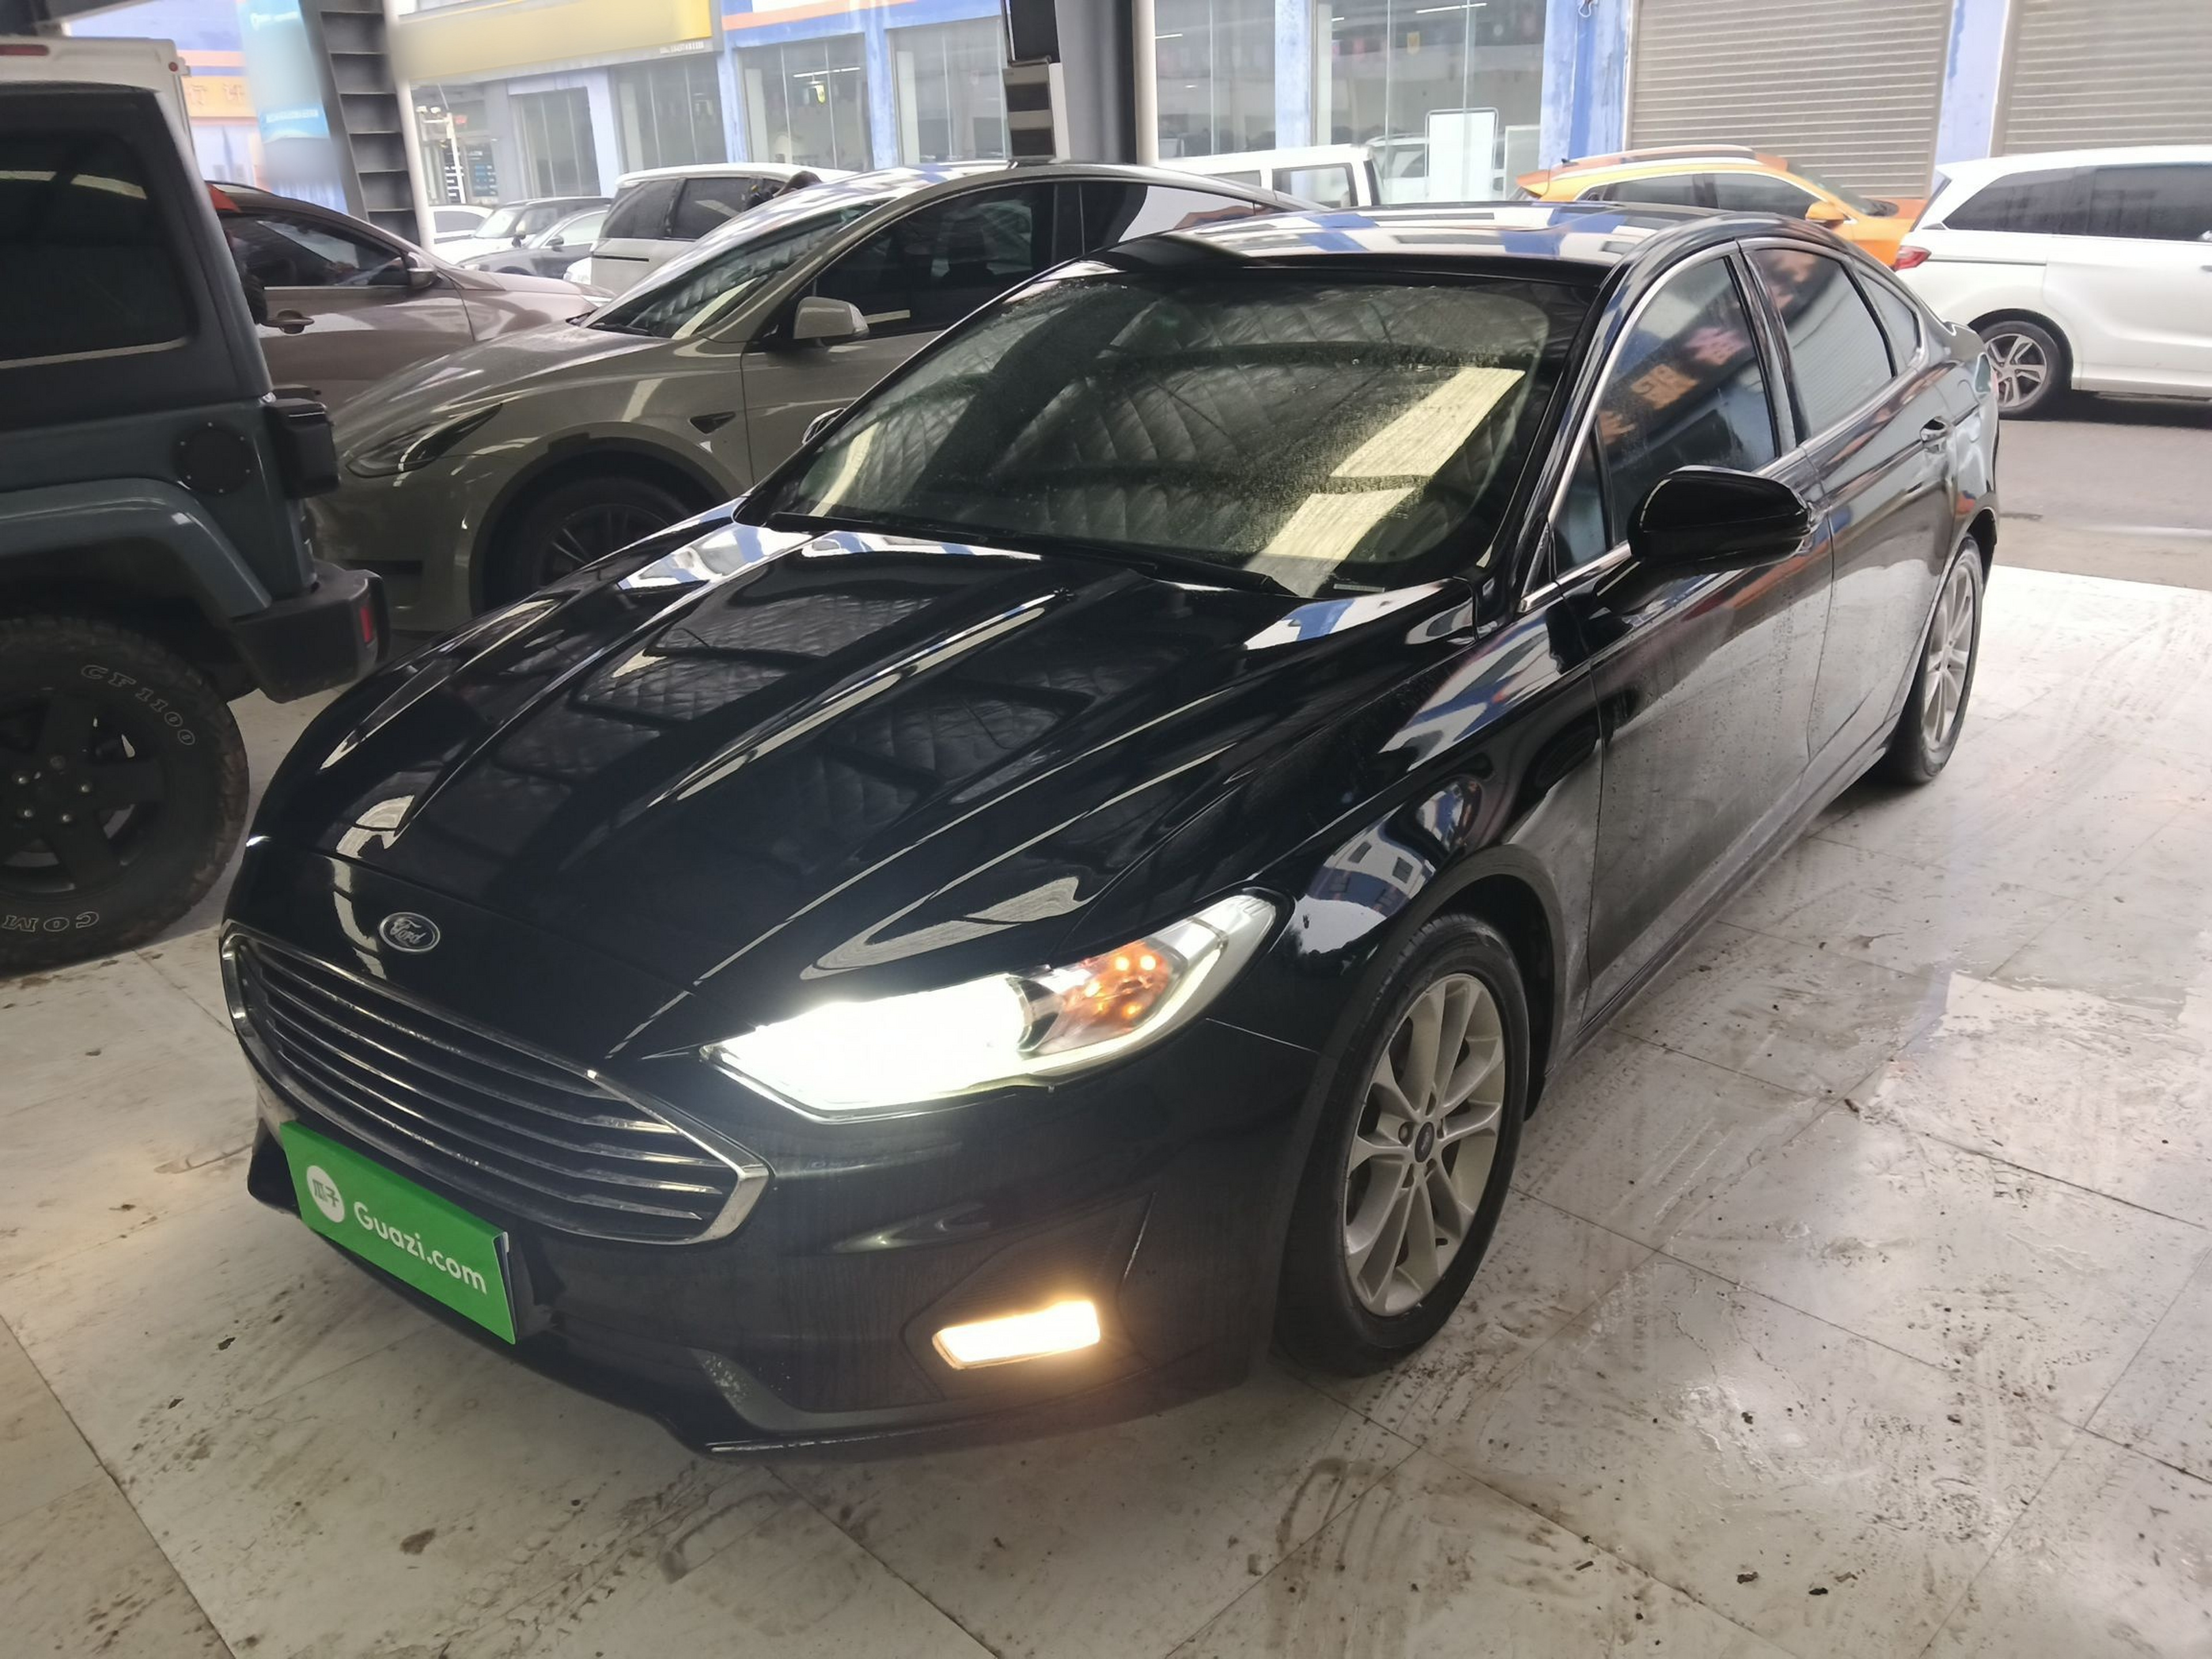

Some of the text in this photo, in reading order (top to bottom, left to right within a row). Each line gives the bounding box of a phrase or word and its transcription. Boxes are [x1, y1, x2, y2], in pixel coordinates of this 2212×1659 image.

[389, 915, 427, 945] Ford
[312, 1178, 340, 1207] 瓜子
[353, 1201, 487, 1295] Guazi.com
